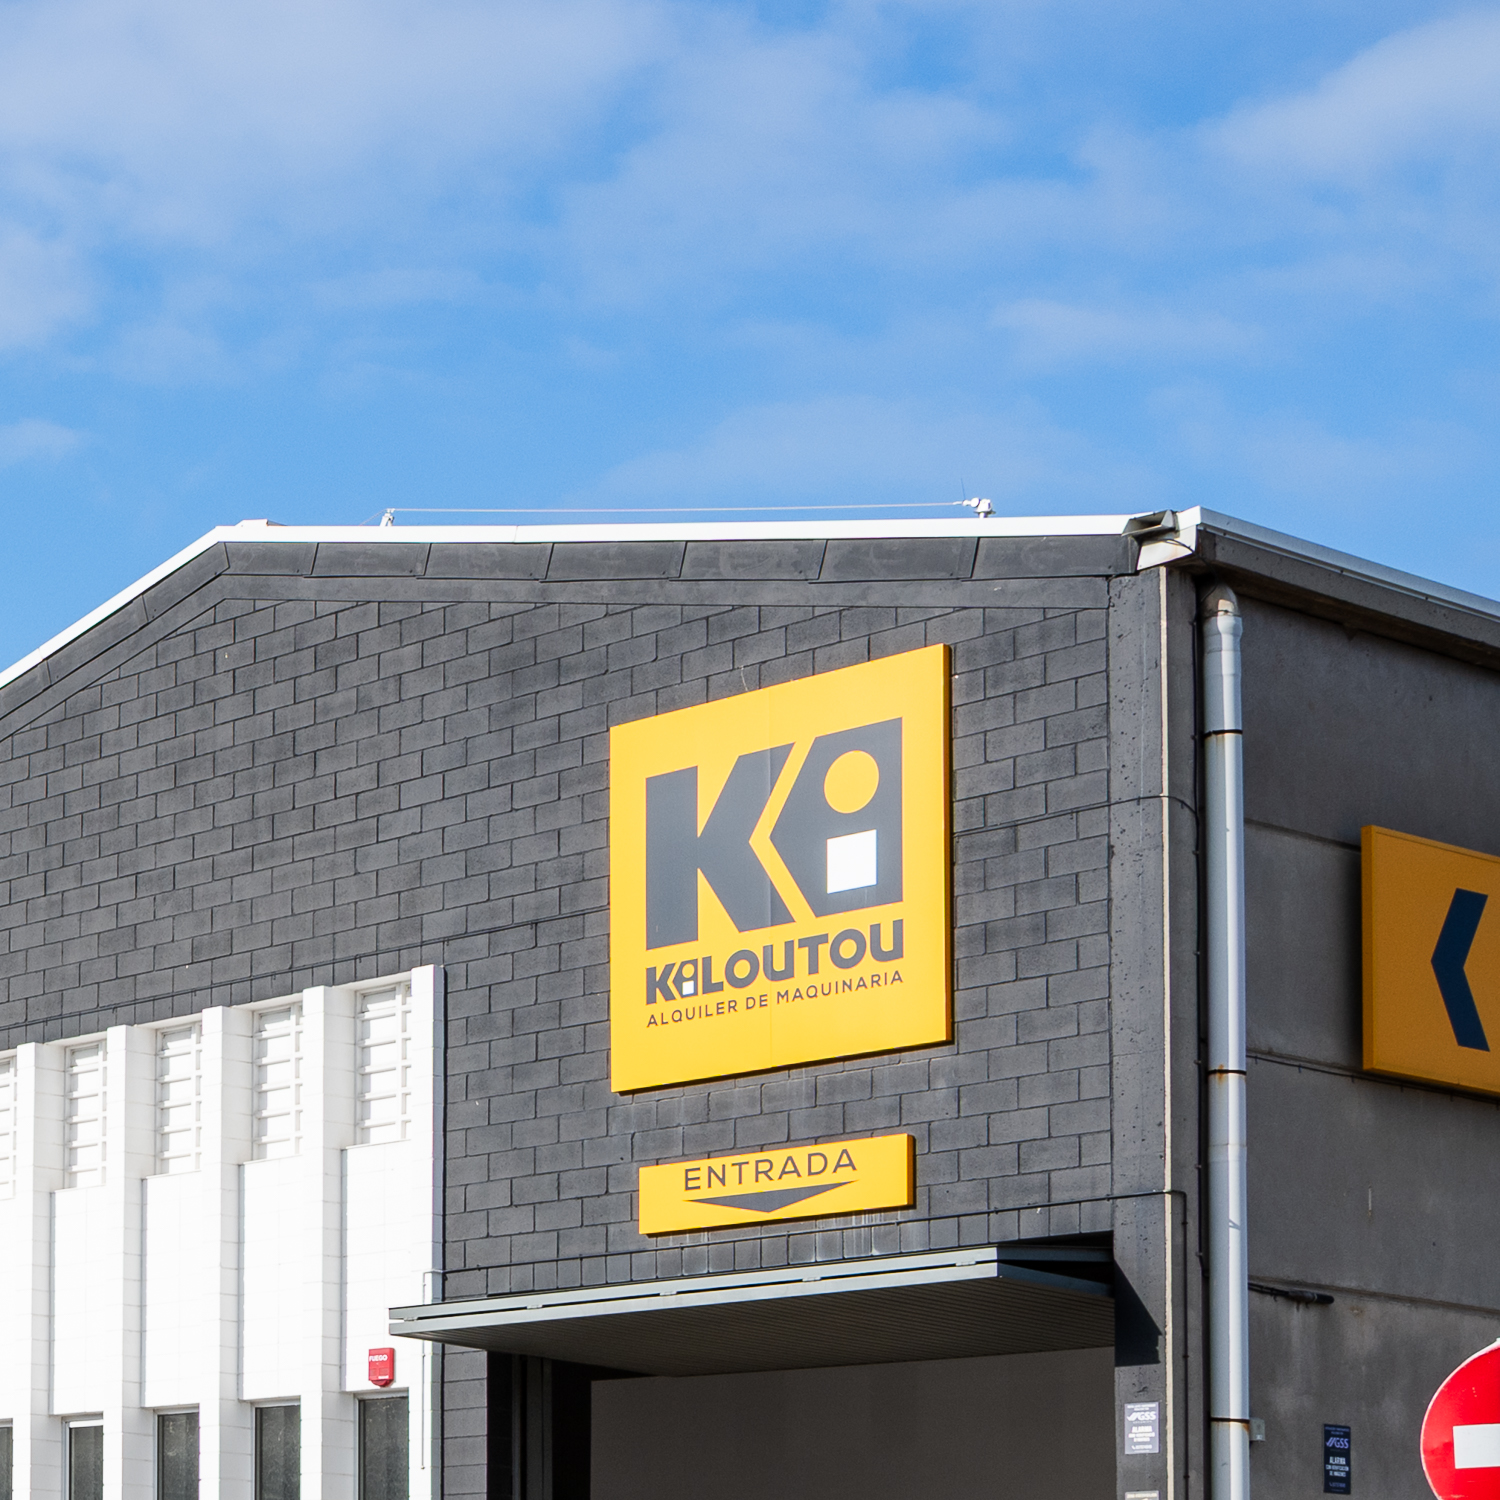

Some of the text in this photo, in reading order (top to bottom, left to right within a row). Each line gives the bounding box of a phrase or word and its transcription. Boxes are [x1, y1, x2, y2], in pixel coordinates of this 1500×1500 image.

[646, 970, 904, 1028] ALQUILER DE MAQUINARIA
[683, 1148, 858, 1191] ENTRADA
[369, 1354, 388, 1362] FUEGO
[1138, 1411, 1157, 1421] GSS
[1334, 1438, 1349, 1449] GSS
